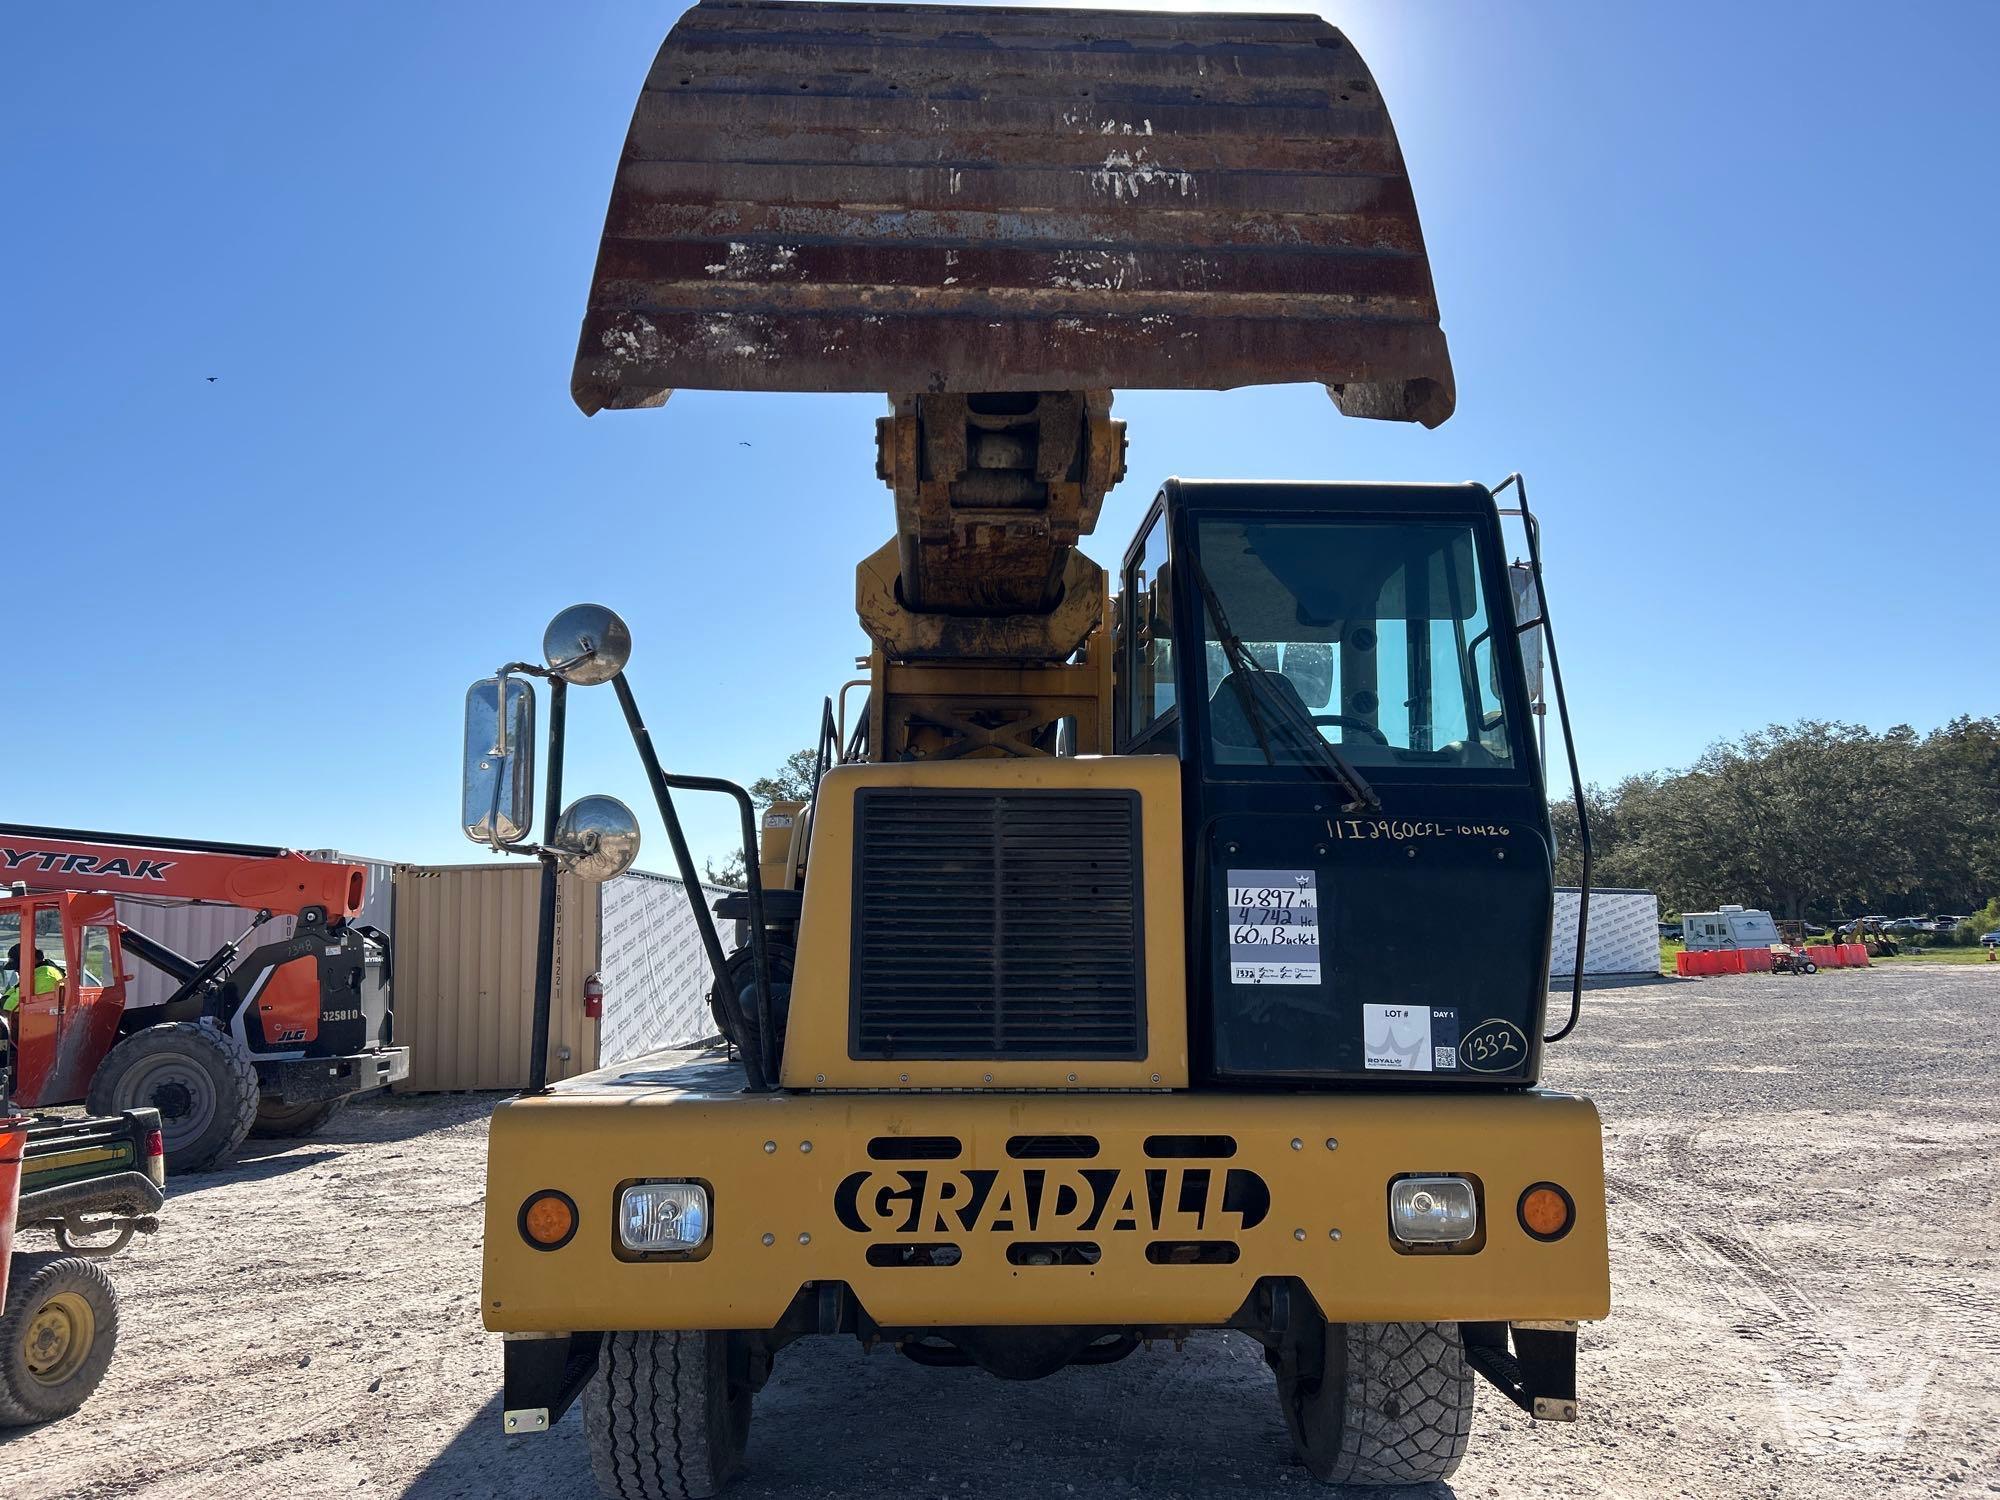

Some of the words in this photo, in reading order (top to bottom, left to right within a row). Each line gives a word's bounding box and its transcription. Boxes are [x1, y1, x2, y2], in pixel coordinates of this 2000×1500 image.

[1234, 889, 1295, 909] 16,897
[1239, 907, 1292, 928] 4,742
[1272, 927, 1316, 945] Bucket
[323, 1009, 358, 1021] 325810
[277, 1029, 307, 1041] JLG
[1468, 1031, 1518, 1061] 1332
[854, 1168, 1245, 1232] GRADALL
